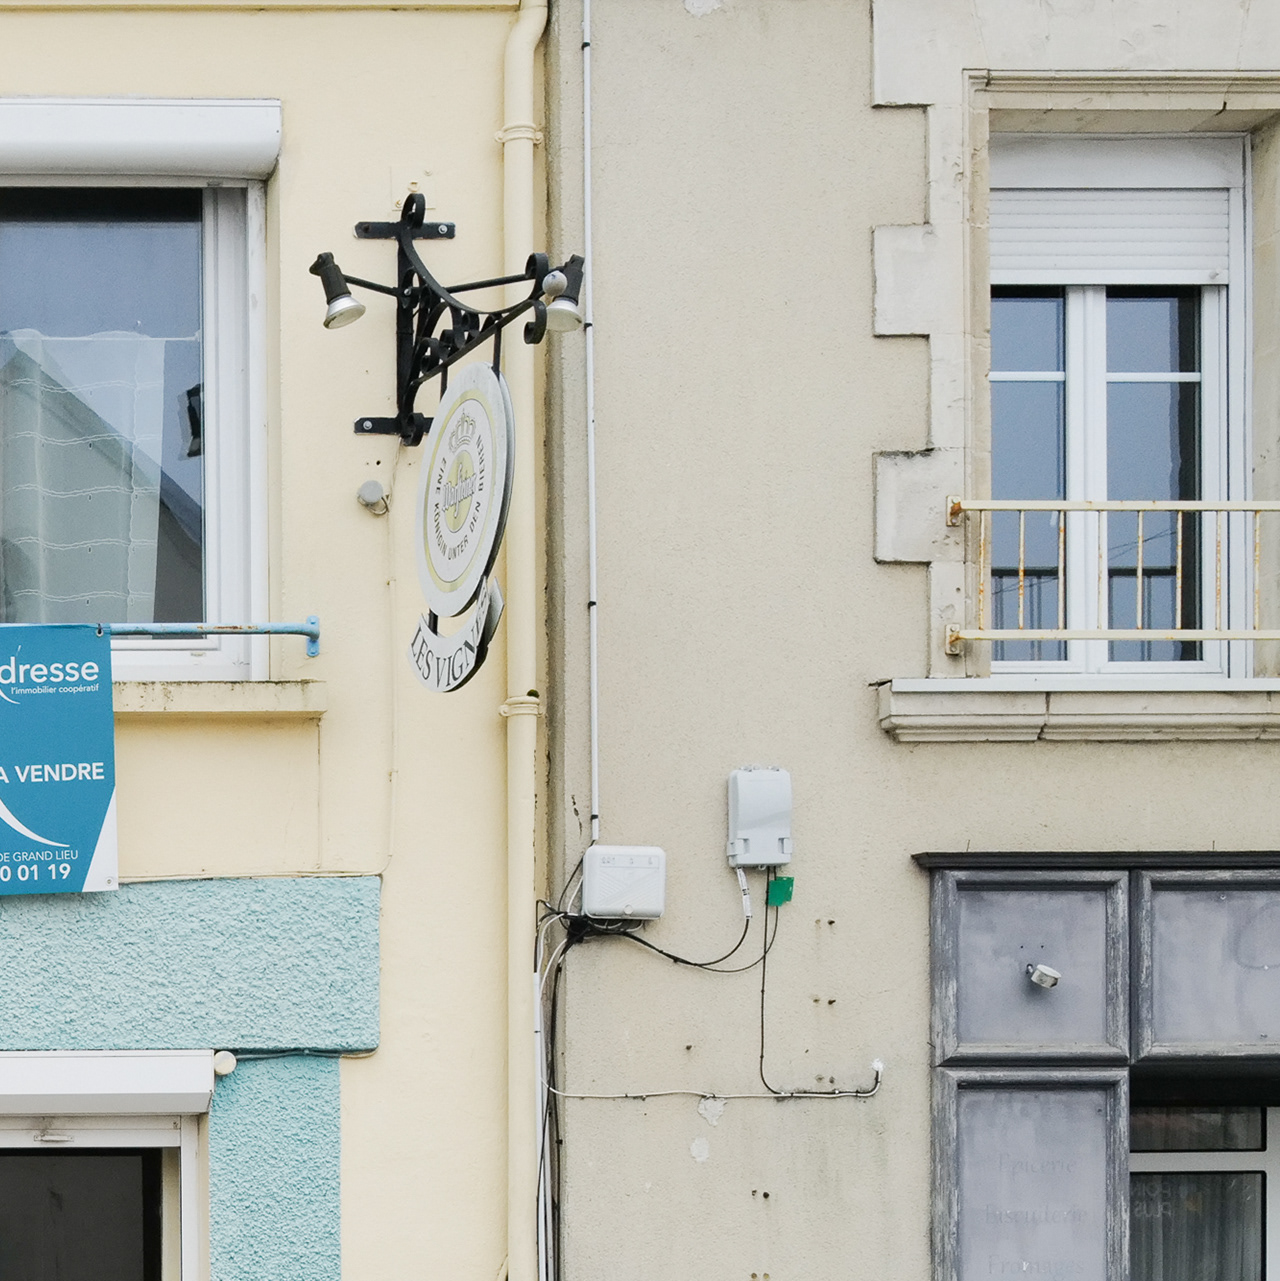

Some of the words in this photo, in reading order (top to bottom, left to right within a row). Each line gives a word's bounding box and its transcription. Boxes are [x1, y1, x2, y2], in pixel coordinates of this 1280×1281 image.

[410, 626, 434, 681] LES
[58, 683, 100, 696] coopératif
[14, 762, 105, 783] VENDRE
[12, 850, 54, 863] GRAND
[55, 849, 79, 861] LIEU
[17, 864, 40, 881] 01
[48, 863, 72, 880] 19
